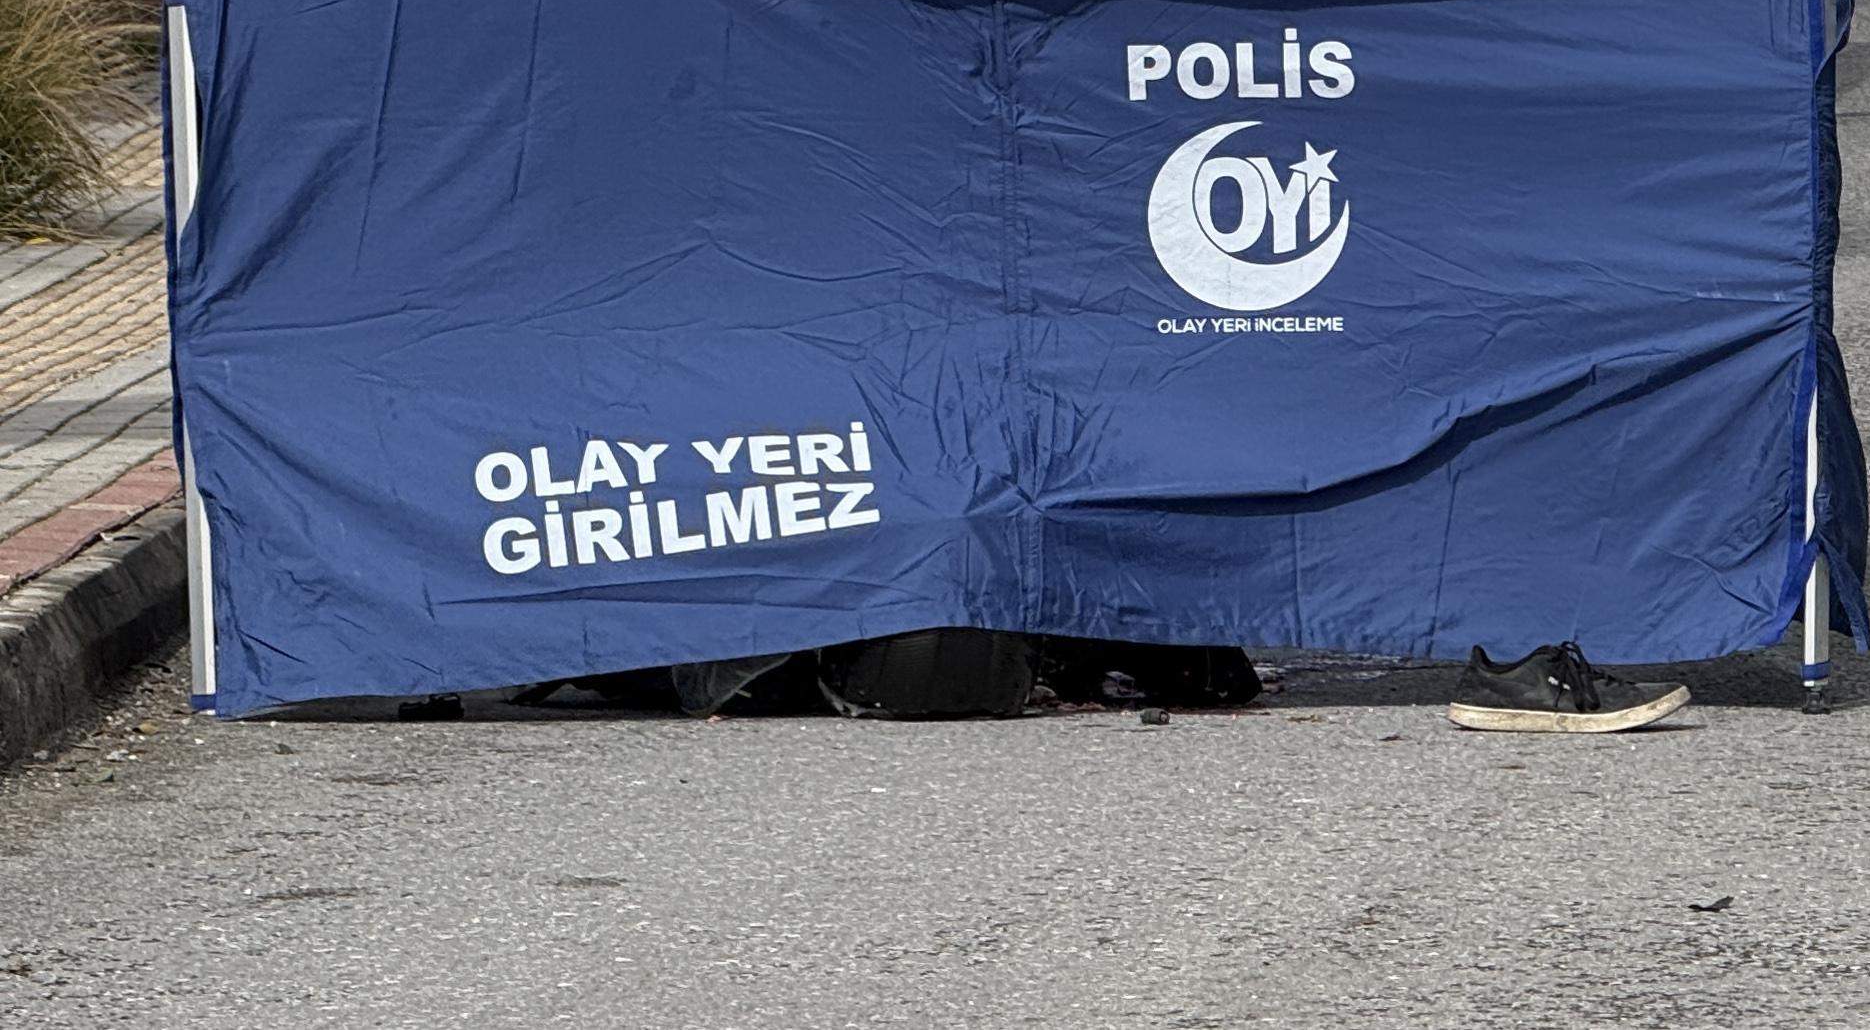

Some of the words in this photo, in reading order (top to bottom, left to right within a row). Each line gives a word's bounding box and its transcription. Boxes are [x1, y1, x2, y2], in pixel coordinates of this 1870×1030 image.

[1127, 27, 1355, 101] POLİS
[1157, 318, 1207, 334] OLAY
[474, 440, 669, 502] OLAY
[691, 421, 872, 476] YERİ
[483, 481, 880, 575] GİRİLMEZ
